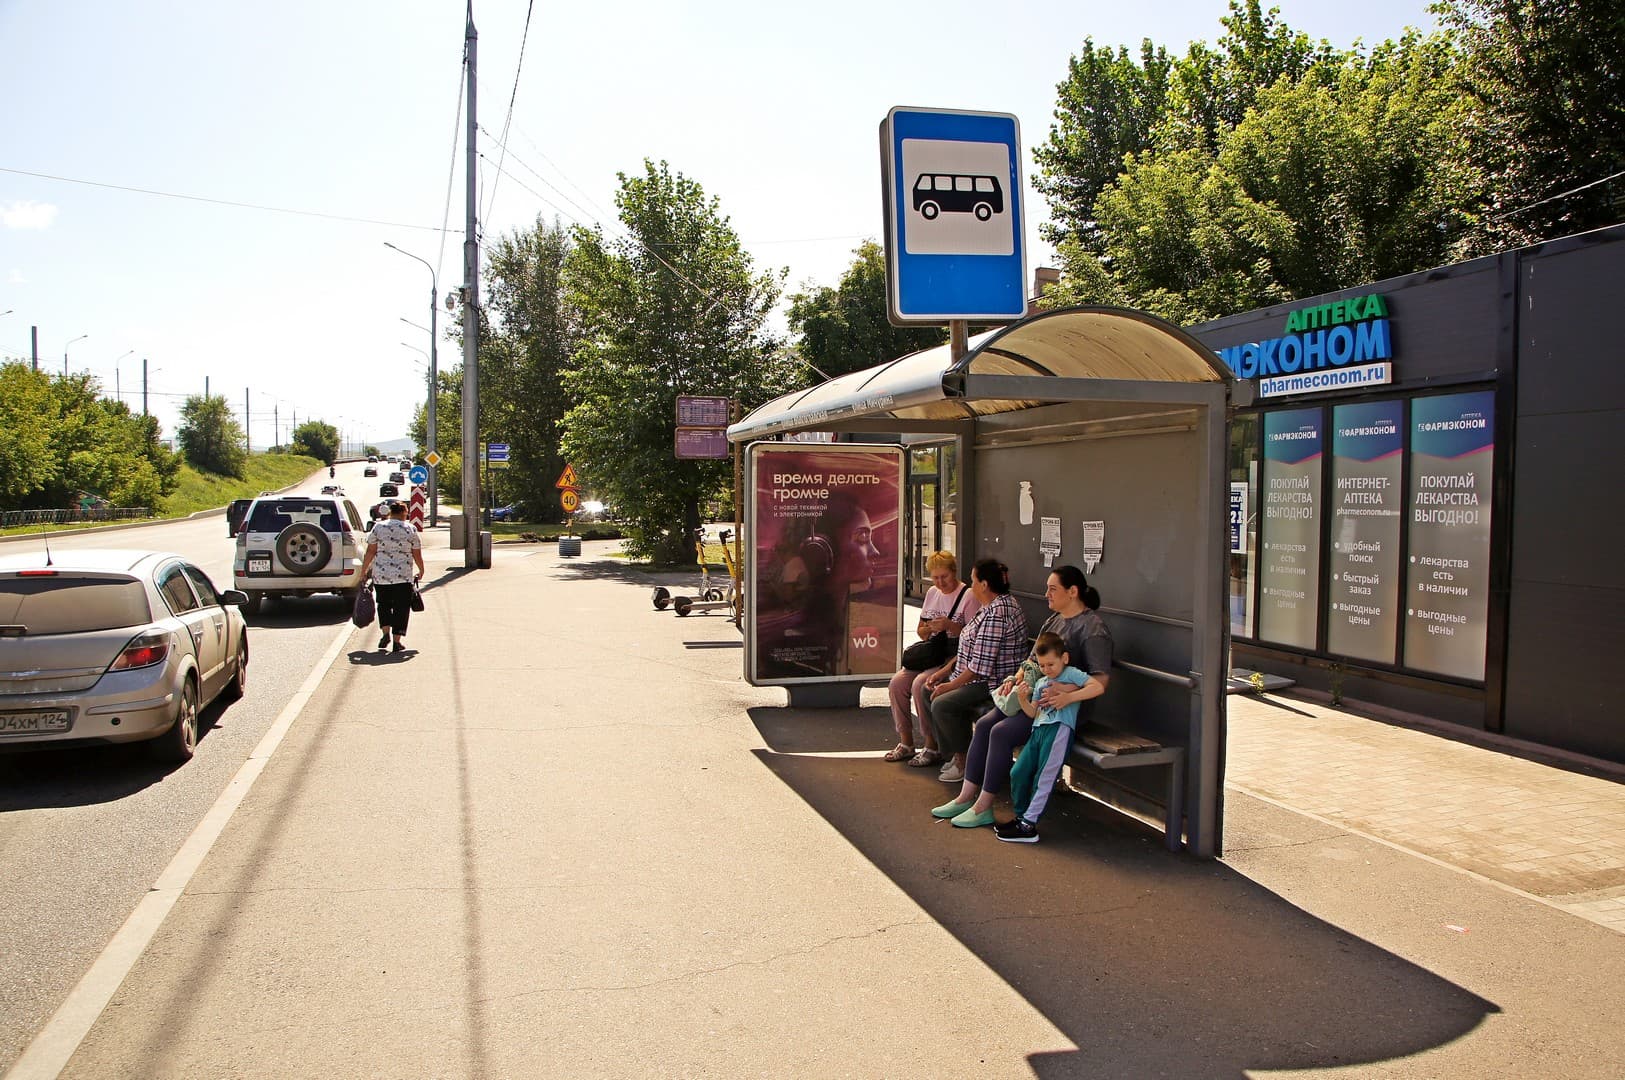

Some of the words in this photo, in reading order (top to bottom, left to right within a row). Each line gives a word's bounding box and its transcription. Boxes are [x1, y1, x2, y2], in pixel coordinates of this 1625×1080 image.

[1284, 293, 1387, 333] АПТЕКА
[1218, 319, 1391, 379] МЭКОНОМ
[1261, 367, 1384, 396] pharmeconom.ru
[1344, 426, 1396, 437] ФАРМЭКОНОМ
[1424, 419, 1486, 431] ФАРМЭКОНОМ
[1273, 431, 1317, 441] ФАРМЭКОНОМ
[773, 473, 823, 488] время
[827, 473, 880, 487] делать
[1270, 475, 1310, 489] ПОКУПАЙ
[1337, 477, 1391, 489] ИНТЕРНЕТ-
[1420, 472, 1475, 489] ПОКУПАЙ
[563, 495, 575, 506] 40
[773, 488, 830, 503] громче
[1267, 492, 1313, 504] ЛЕКАРСТВА
[1343, 492, 1383, 504] АПТЕКА
[1415, 493, 1479, 506] ЛЕКАРСТВА
[1266, 506, 1313, 521] ВЫГОДНО!
[1336, 506, 1391, 516] pharmeconom.ru
[1414, 509, 1479, 527] ВЫГОДНО!
[1343, 540, 1381, 552] удобный
[1349, 554, 1373, 563] поиск
[1420, 556, 1469, 569] лекарства
[1343, 571, 1379, 585] быстрый
[1433, 571, 1454, 581] есть
[1349, 586, 1372, 595] заказ
[1418, 583, 1424, 591] в
[1426, 584, 1468, 596] наличии
[1339, 602, 1381, 616] выгодные
[1348, 615, 1370, 626] цены
[1417, 609, 1467, 624] выгодные
[1428, 624, 1454, 636] цены
[853, 633, 878, 649] wb
[42, 713, 66, 725] 124
